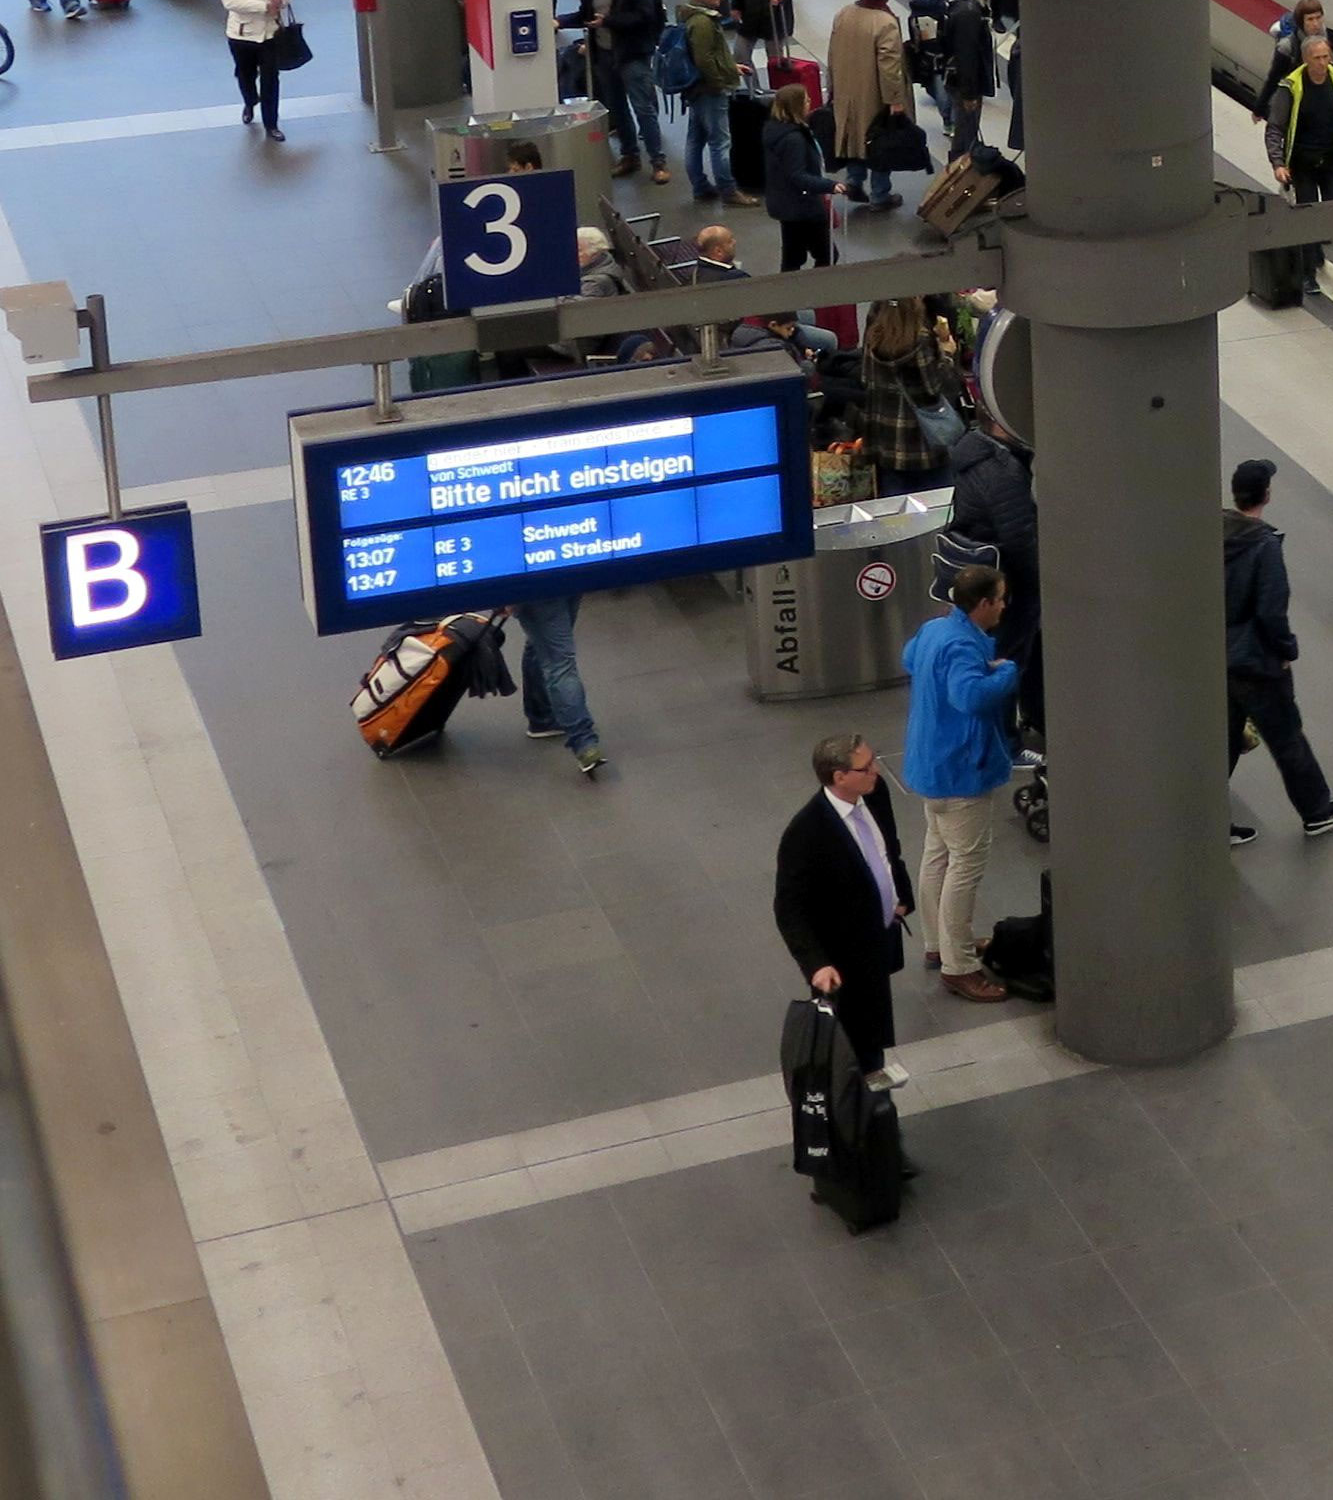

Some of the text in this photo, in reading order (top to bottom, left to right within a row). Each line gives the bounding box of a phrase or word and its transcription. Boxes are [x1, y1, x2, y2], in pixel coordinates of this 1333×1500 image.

[462, 183, 528, 276] 3
[341, 463, 396, 486] 12:46
[430, 460, 514, 483] von Schwedt
[430, 454, 693, 510] Bitte nicht einsteigen
[341, 487, 370, 501] RE 3
[522, 516, 597, 543] Schwedt
[434, 536, 472, 555] RE 3
[524, 532, 642, 565] von Stralsund
[346, 547, 396, 569] 13:07
[436, 559, 474, 578] RE 3
[66, 528, 148, 628] B
[347, 569, 397, 592] 13:47
[772, 589, 800, 674] Abfall
